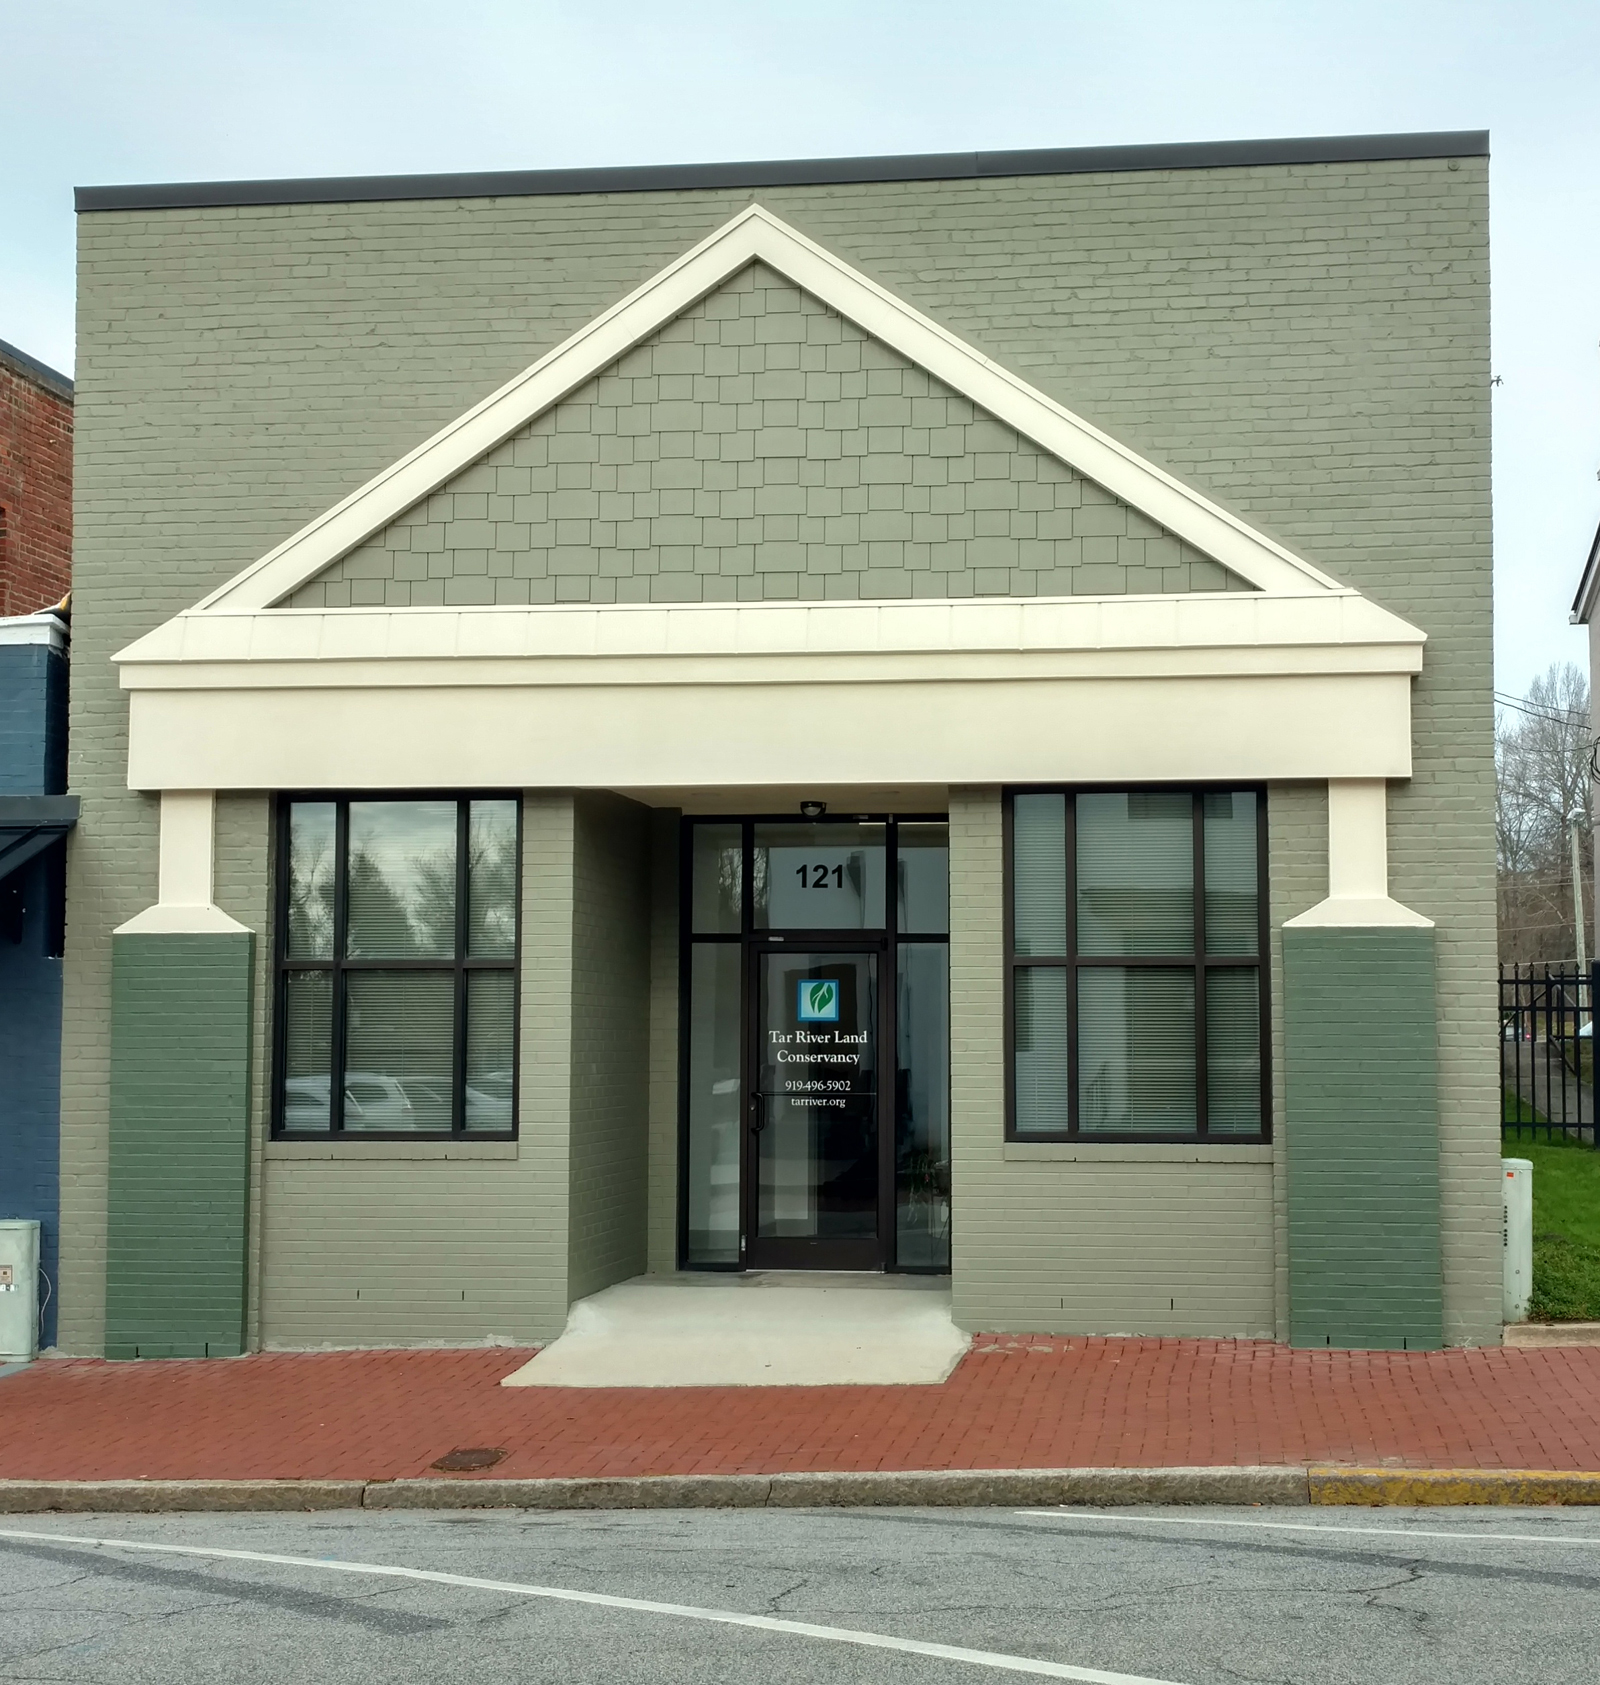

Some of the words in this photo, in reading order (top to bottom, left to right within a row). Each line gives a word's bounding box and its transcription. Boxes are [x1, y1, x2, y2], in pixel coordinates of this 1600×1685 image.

[795, 864, 844, 889] 121
[768, 1030, 793, 1044] Tar
[795, 1030, 831, 1044] River
[834, 1030, 868, 1044] Land
[776, 1050, 860, 1065] Conservancy
[785, 1080, 851, 1092] 919-496-5902
[791, 1096, 846, 1108] tarriver.org
